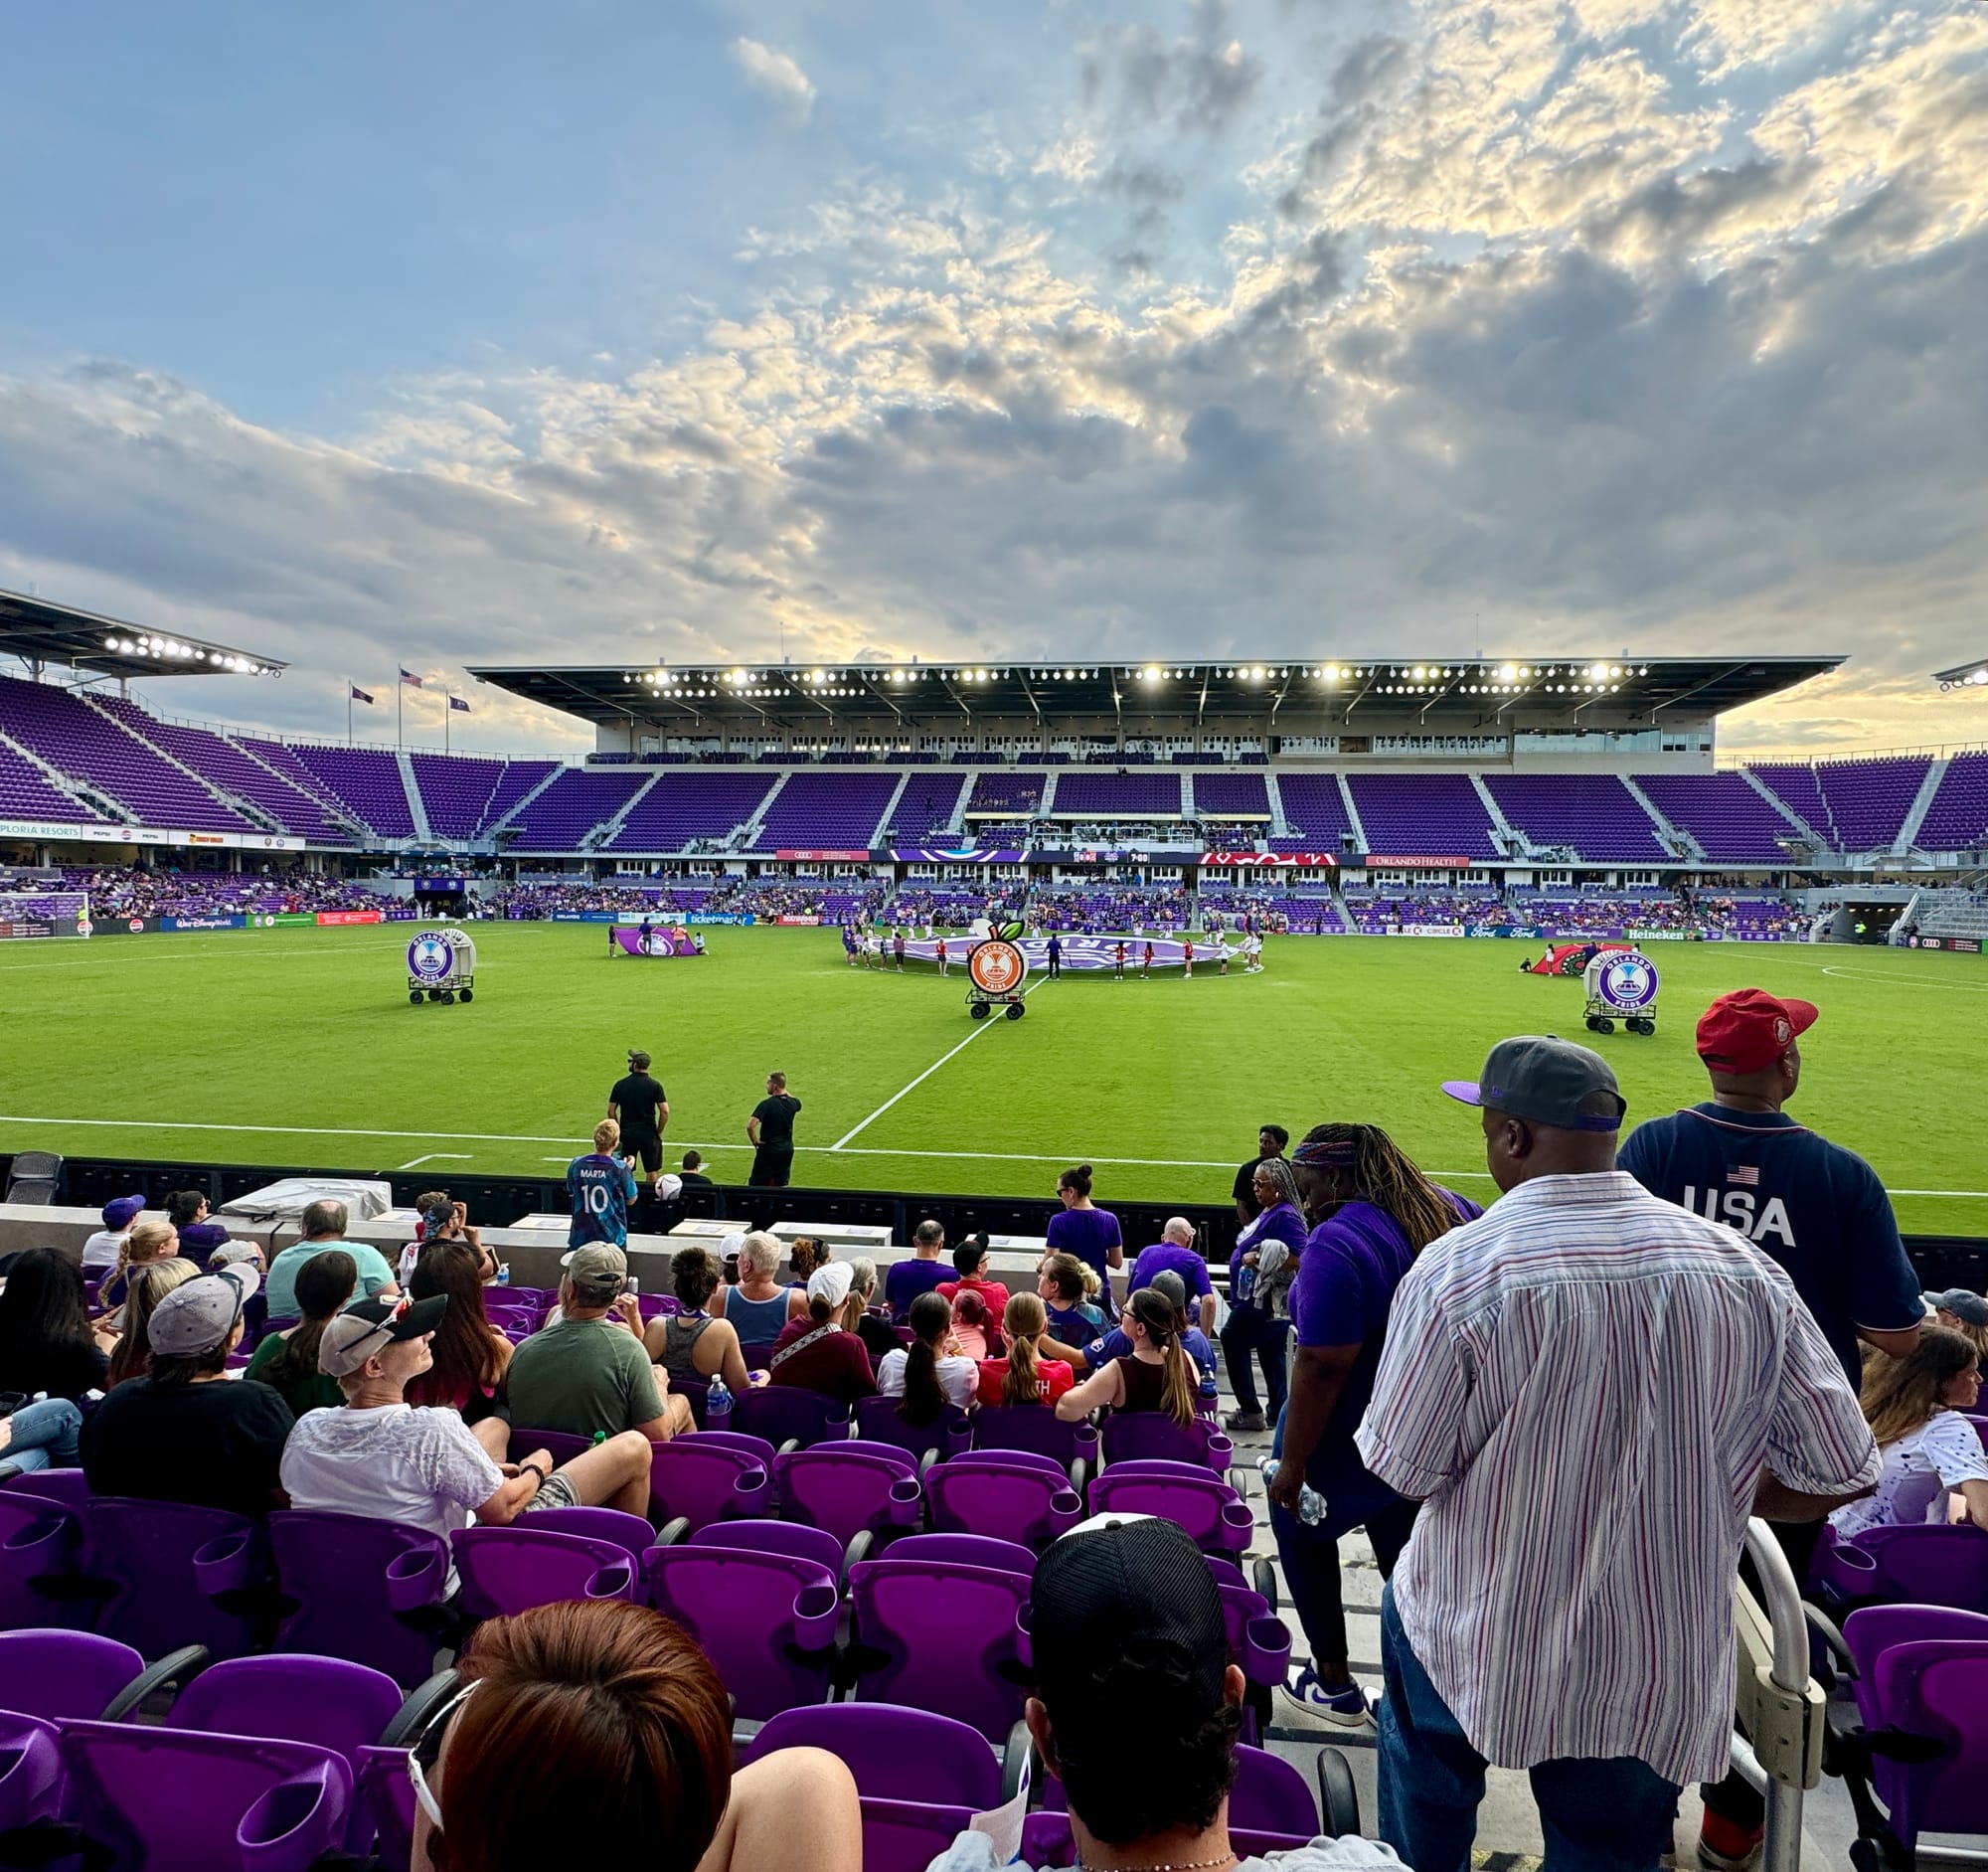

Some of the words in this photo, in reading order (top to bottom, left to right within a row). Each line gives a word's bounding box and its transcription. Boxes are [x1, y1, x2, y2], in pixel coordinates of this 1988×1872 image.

[41, 826, 79, 836] RESORTS
[1376, 857, 1421, 866] ORLANDO
[1421, 857, 1456, 866] HEALTH
[1471, 926, 1497, 937] Ford
[1510, 927, 1537, 937] Ford
[1629, 930, 1685, 940] Heineken
[414, 934, 448, 947] ORLANDO
[978, 944, 1014, 957] ORLANDO
[1606, 955, 1651, 970] ORLANDO
[418, 973, 440, 982] PRIDE
[1614, 999, 1641, 1008] PRIDE
[580, 1169, 606, 1179] MARTA
[581, 1184, 609, 1214] 10
[1684, 1185, 1796, 1248] USA
